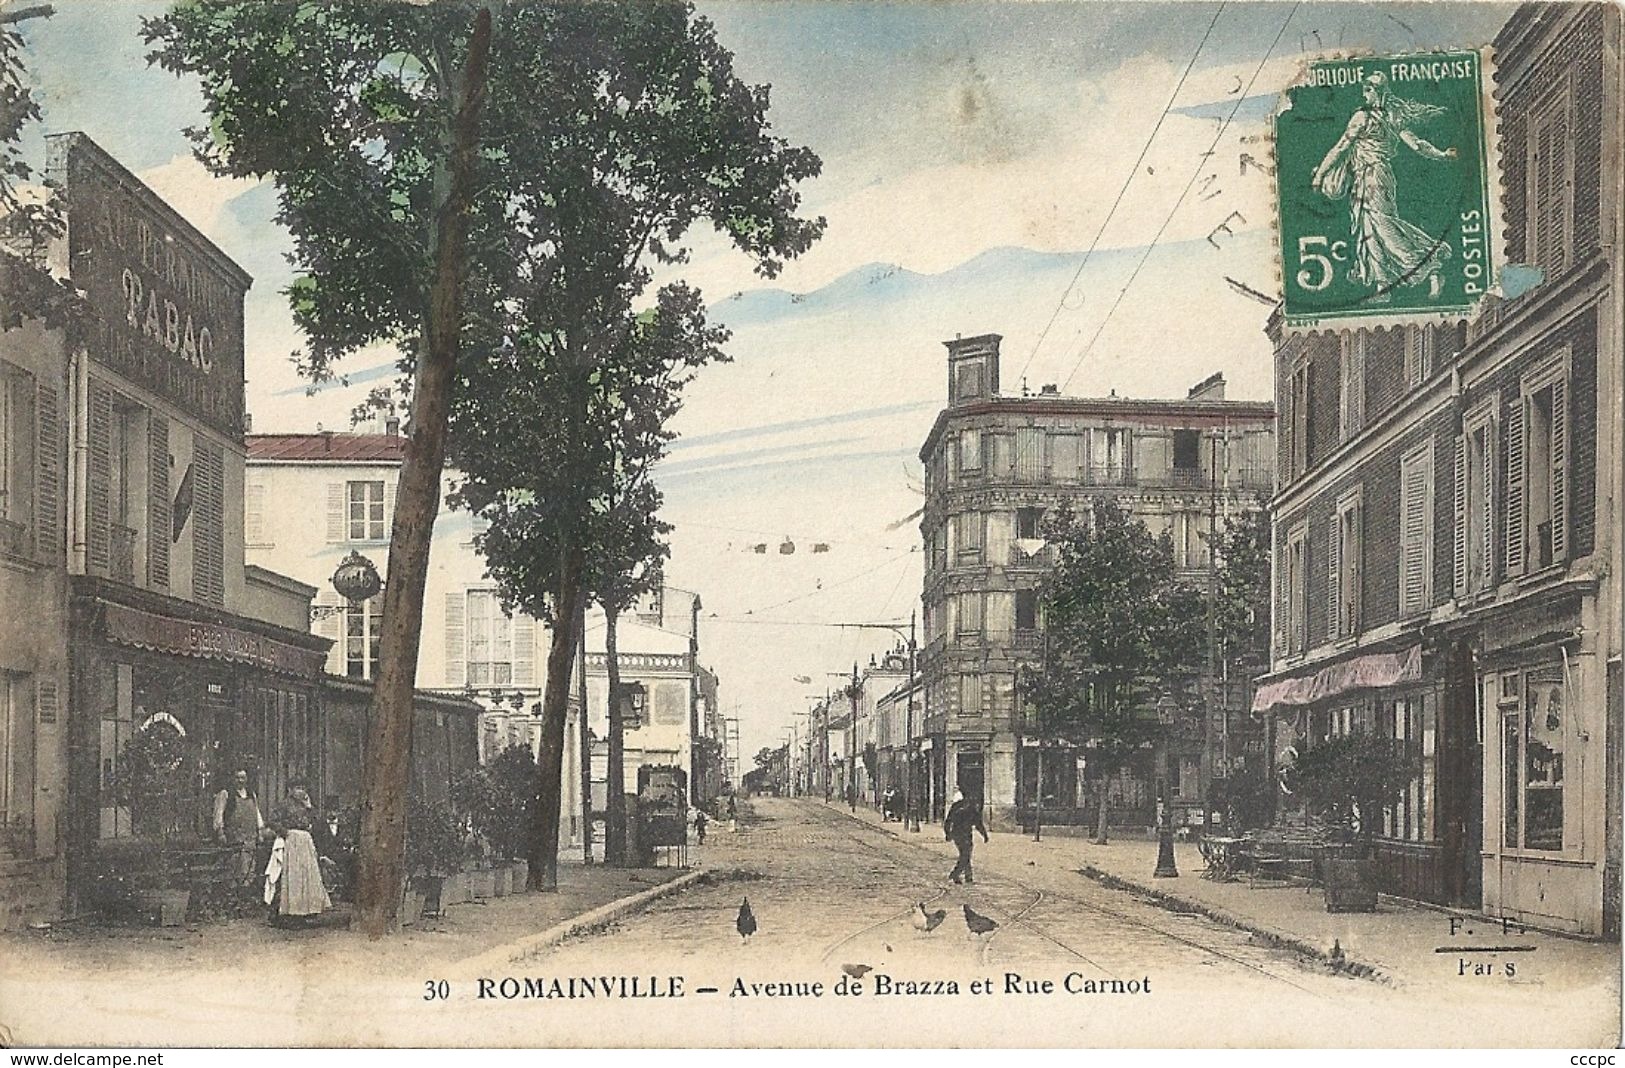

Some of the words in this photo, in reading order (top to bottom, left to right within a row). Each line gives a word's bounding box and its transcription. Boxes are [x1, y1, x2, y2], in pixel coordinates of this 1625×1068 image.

[1306, 66, 1364, 88] UBLIQUE
[1391, 60, 1473, 83] FRANÇAISE
[1461, 209, 1483, 294] POSTES
[122, 267, 213, 375] TABAC
